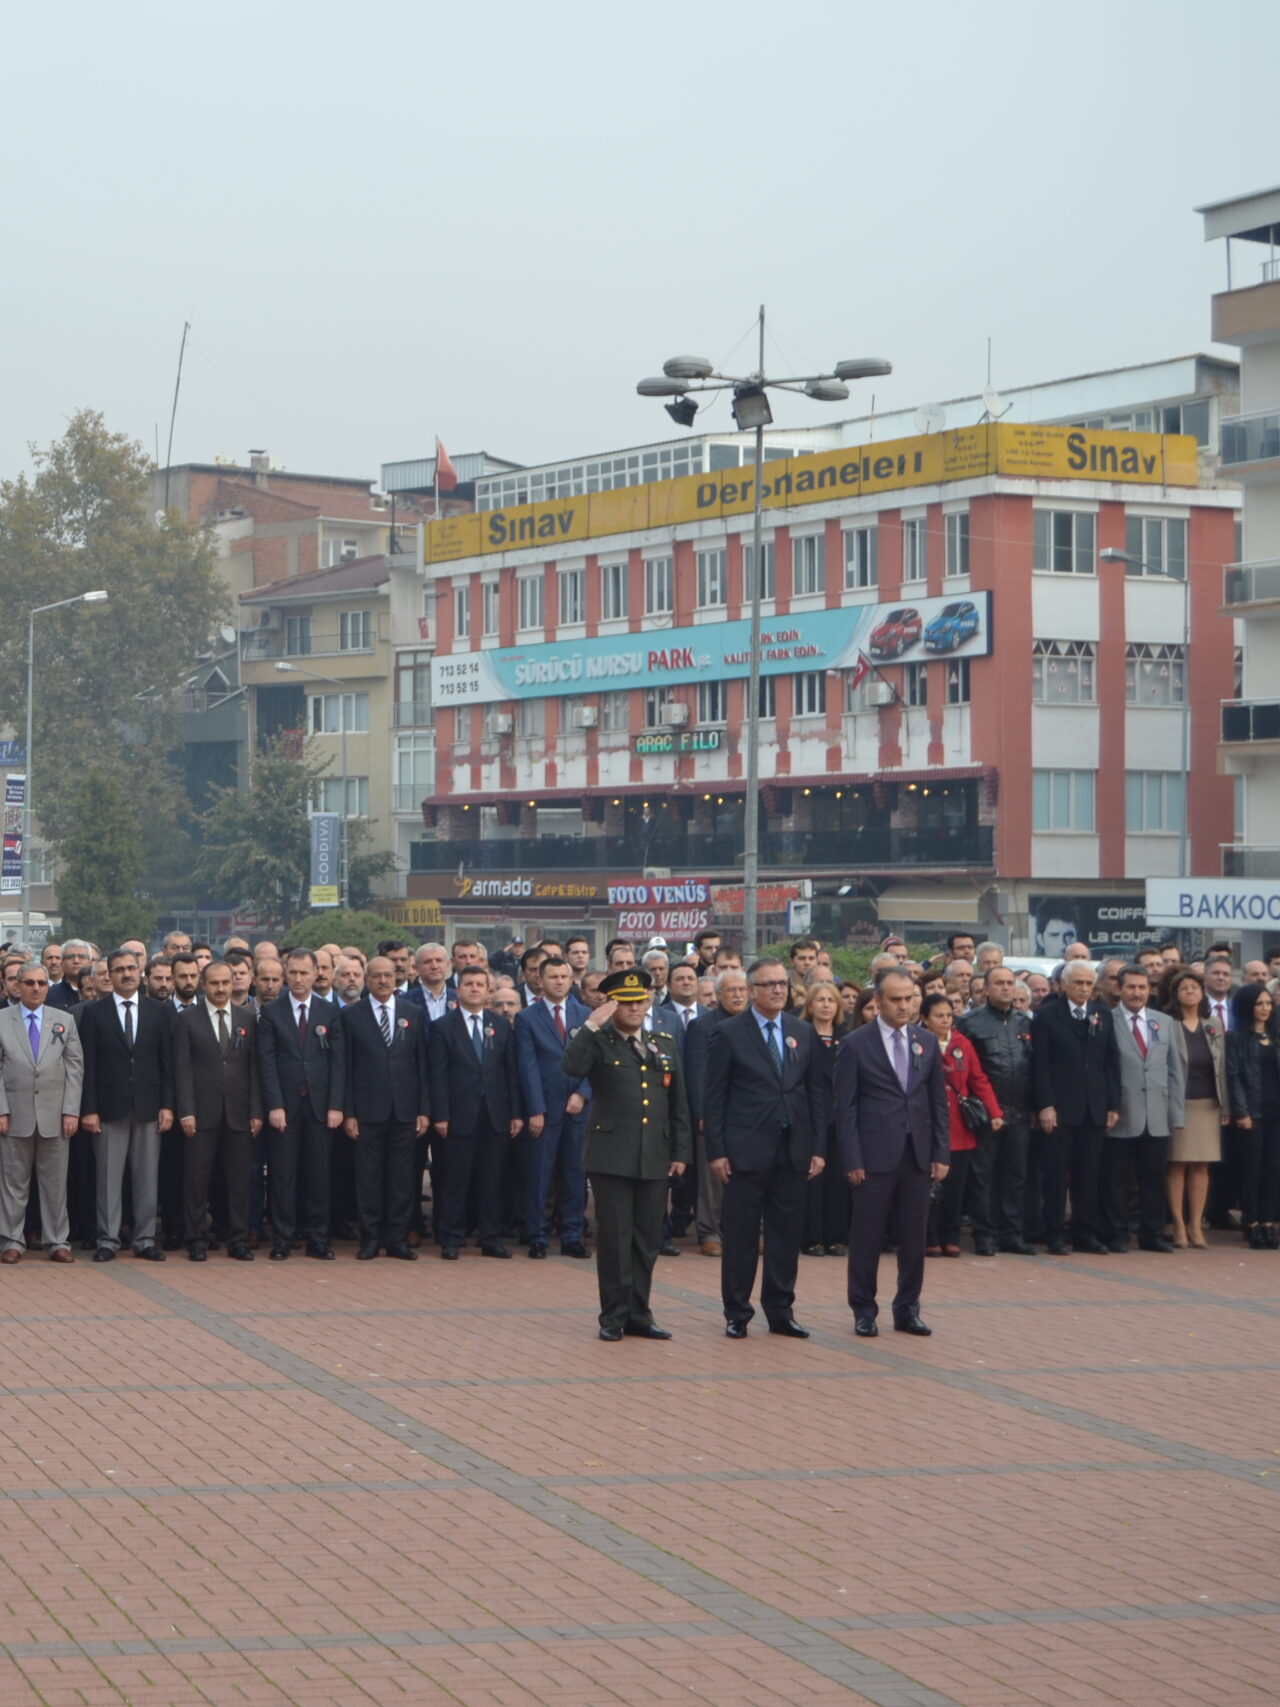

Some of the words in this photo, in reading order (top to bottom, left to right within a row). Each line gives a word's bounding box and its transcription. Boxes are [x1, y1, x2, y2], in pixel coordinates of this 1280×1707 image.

[1066, 431, 1156, 475] Sınav
[488, 509, 575, 544] Sınav
[515, 653, 582, 685] SÜRÜCÜ
[586, 651, 642, 679] KURSU
[648, 647, 695, 672] PARK
[767, 648, 791, 660] FARK
[440, 665, 454, 677] 713
[457, 664, 467, 675] 52
[469, 662, 479, 673] 14
[440, 683, 454, 695] 713
[457, 682, 467, 693] 52
[469, 680, 479, 692] 15
[319, 820, 329, 884] CODDIVA
[608, 886, 648, 905] FOTO
[652, 880, 707, 904] VENÜS
[619, 912, 655, 929] FOTO
[661, 908, 708, 929] VENÜS
